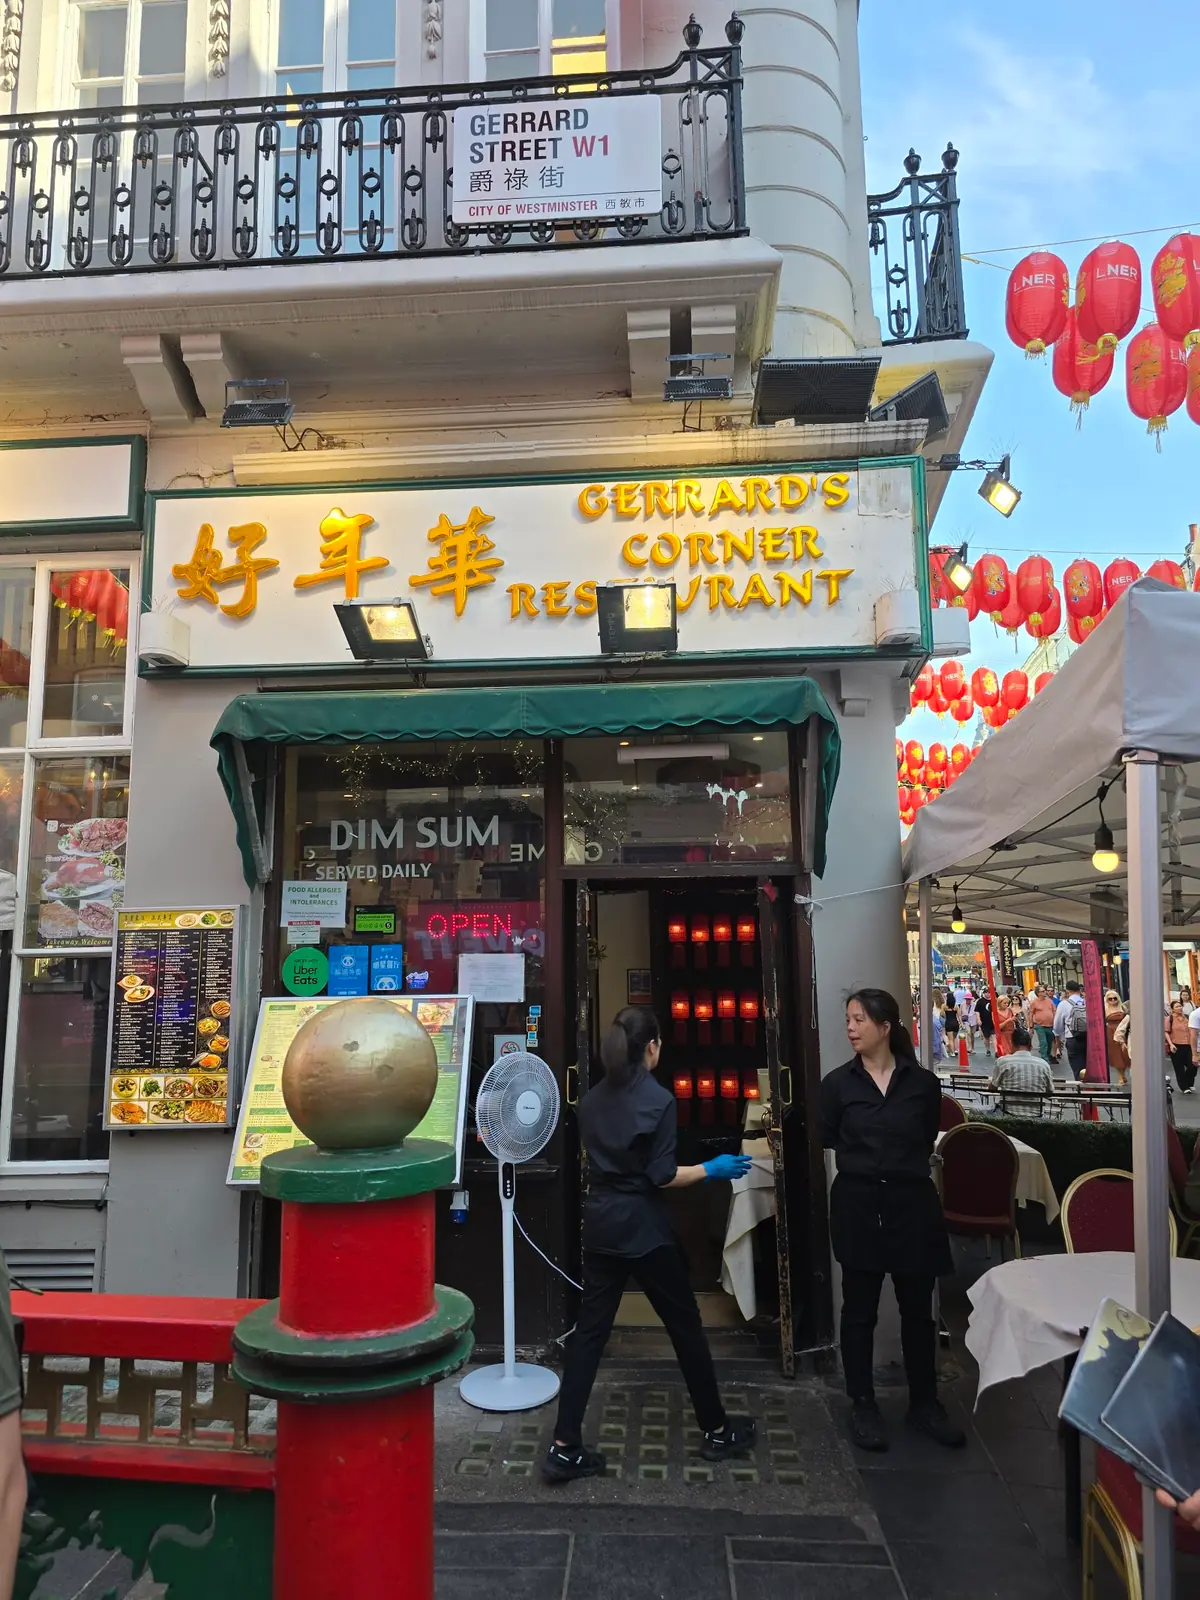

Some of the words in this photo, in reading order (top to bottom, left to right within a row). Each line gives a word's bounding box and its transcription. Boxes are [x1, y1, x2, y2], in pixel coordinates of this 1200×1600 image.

[470, 108, 589, 137] GERRARD
[469, 136, 563, 164] STREET
[572, 134, 611, 158] W1
[468, 204, 494, 217] CITY
[497, 203, 512, 216] OF
[515, 199, 598, 214] WESTMINSTER
[605, 197, 645, 210] 西敏市
[1013, 273, 1056, 292] LNER
[1096, 263, 1138, 281] LNER
[577, 473, 850, 518] GERRARD'S
[621, 525, 824, 568] CORNER
[172, 505, 505, 618] 好年華
[506, 568, 855, 619] RESURANT
[330, 818, 404, 851] DIM
[416, 815, 499, 849] SUM
[315, 865, 377, 881] SERVED
[382, 862, 432, 879] DAILY
[427, 913, 512, 938] OPEN
[45, 938, 79, 946] Takeaway
[293, 965, 319, 975] Uber
[293, 975, 318, 985] Eats
